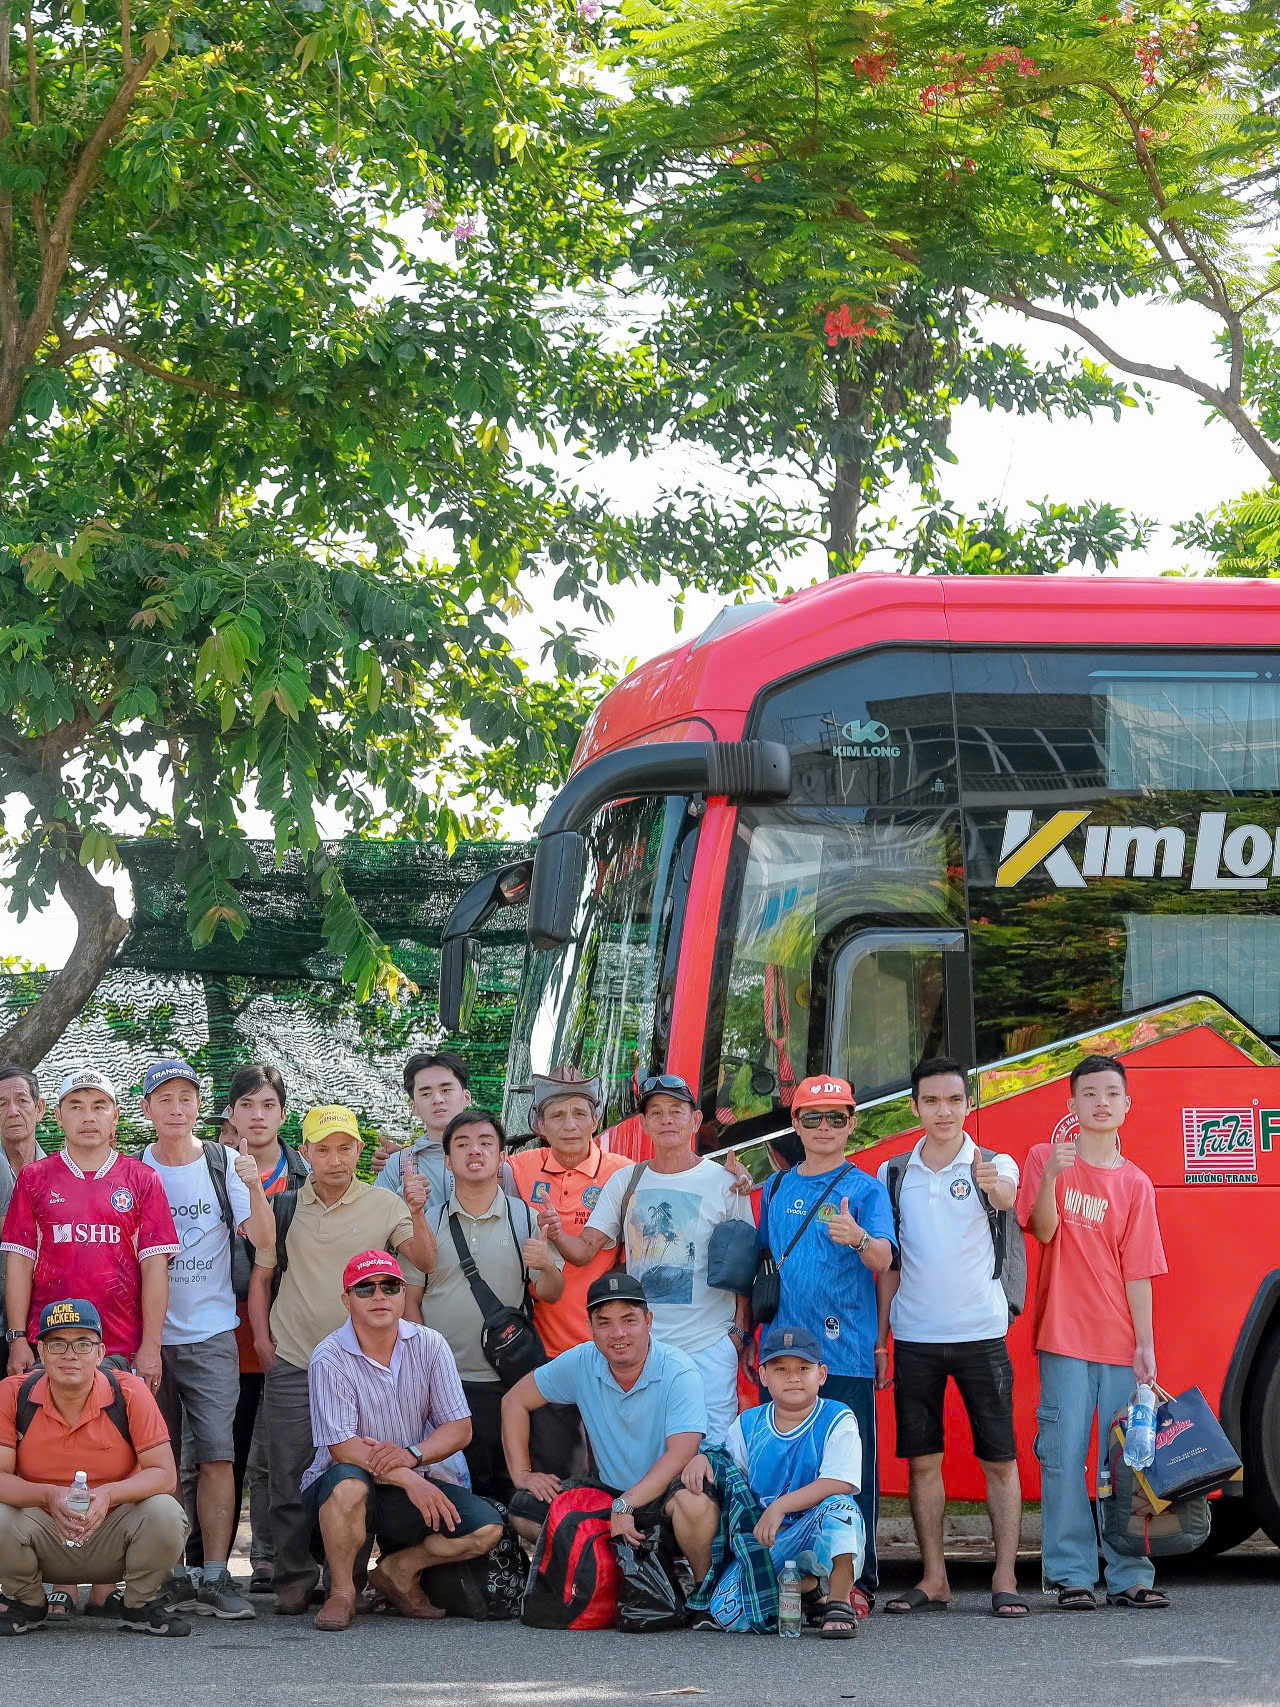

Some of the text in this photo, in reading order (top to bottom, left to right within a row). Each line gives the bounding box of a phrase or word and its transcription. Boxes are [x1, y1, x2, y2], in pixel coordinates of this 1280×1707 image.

[832, 745, 900, 757] KIM LONG
[152, 1068, 193, 1081] TRANSVIET
[824, 1083, 842, 1093] DT
[1185, 1171, 1258, 1184] PHƯƠNG TRANG
[169, 1199, 212, 1220] oogle
[75, 1223, 121, 1244] SHB
[191, 1275, 207, 1283] 2019
[53, 1304, 74, 1314] ACME
[47, 1312, 80, 1327] PACKERS
